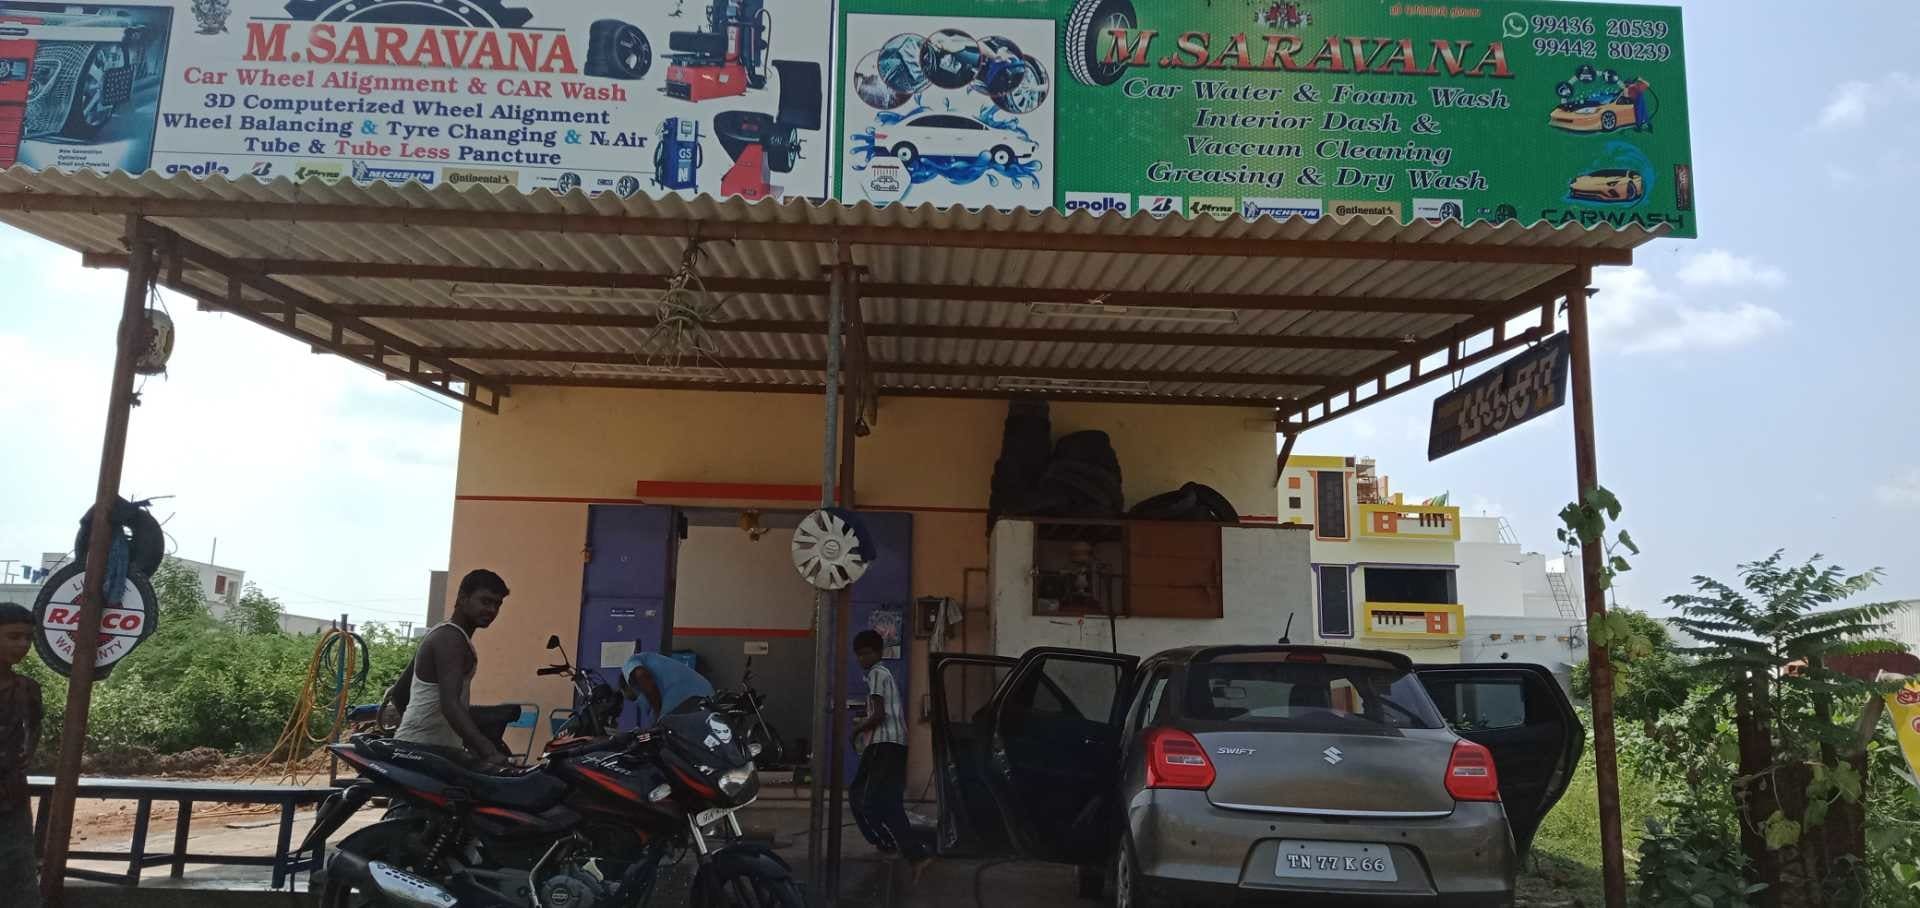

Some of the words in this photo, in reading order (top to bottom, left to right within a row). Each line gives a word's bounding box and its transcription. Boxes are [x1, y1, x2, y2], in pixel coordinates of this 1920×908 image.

[1531, 15, 1594, 35] 99436
[1606, 18, 1669, 39] 20539
[242, 22, 577, 75] M.SARAVANA
[1100, 28, 1515, 78] M.SARAVANA
[1534, 38, 1597, 59] 99442
[1608, 42, 1671, 61] 80239
[184, 67, 228, 85] Car
[237, 68, 314, 88] Wheel
[322, 70, 458, 95] Alignment
[467, 77, 488, 95] &
[496, 79, 552, 98] CAR
[561, 82, 627, 102] Wash
[1123, 78, 1183, 99] Car
[1192, 81, 1283, 102] Water
[1293, 84, 1322, 103] &
[1332, 84, 1416, 106] Foam
[1431, 87, 1510, 109] Wash
[204, 93, 235, 109] 3D
[243, 94, 403, 115] Computerized
[413, 100, 482, 119] Wheel
[491, 105, 610, 126] Alignment
[1195, 109, 1311, 130] Interior
[1321, 111, 1400, 133] Dash
[1412, 115, 1440, 134] &
[163, 113, 231, 131] Wheel
[239, 116, 353, 138] Balancing
[360, 120, 377, 136] &
[387, 121, 439, 143] Tyre
[448, 124, 557, 148] Changing
[564, 129, 581, 144] &
[612, 132, 648, 148] Air
[244, 136, 301, 153] Tube
[309, 140, 326, 154] &
[335, 140, 392, 157] Tube
[400, 142, 450, 160] Less
[459, 146, 561, 165] Pancture
[1186, 136, 1301, 158] Vaccum
[1316, 140, 1452, 165] Cleaning
[1147, 161, 1283, 189] Greasing
[1297, 167, 1324, 186] &
[1334, 167, 1393, 191] Dry
[1408, 168, 1488, 190] Wash
[47, 607, 140, 630] RACO
[55, 634, 123, 662] WANTY
[1217, 745, 1256, 756] SWIFT
[1288, 855, 1312, 870] TN
[1317, 857, 1339, 871] 77
[1344, 858, 1358, 871] K
[1362, 859, 1386, 872] 66
